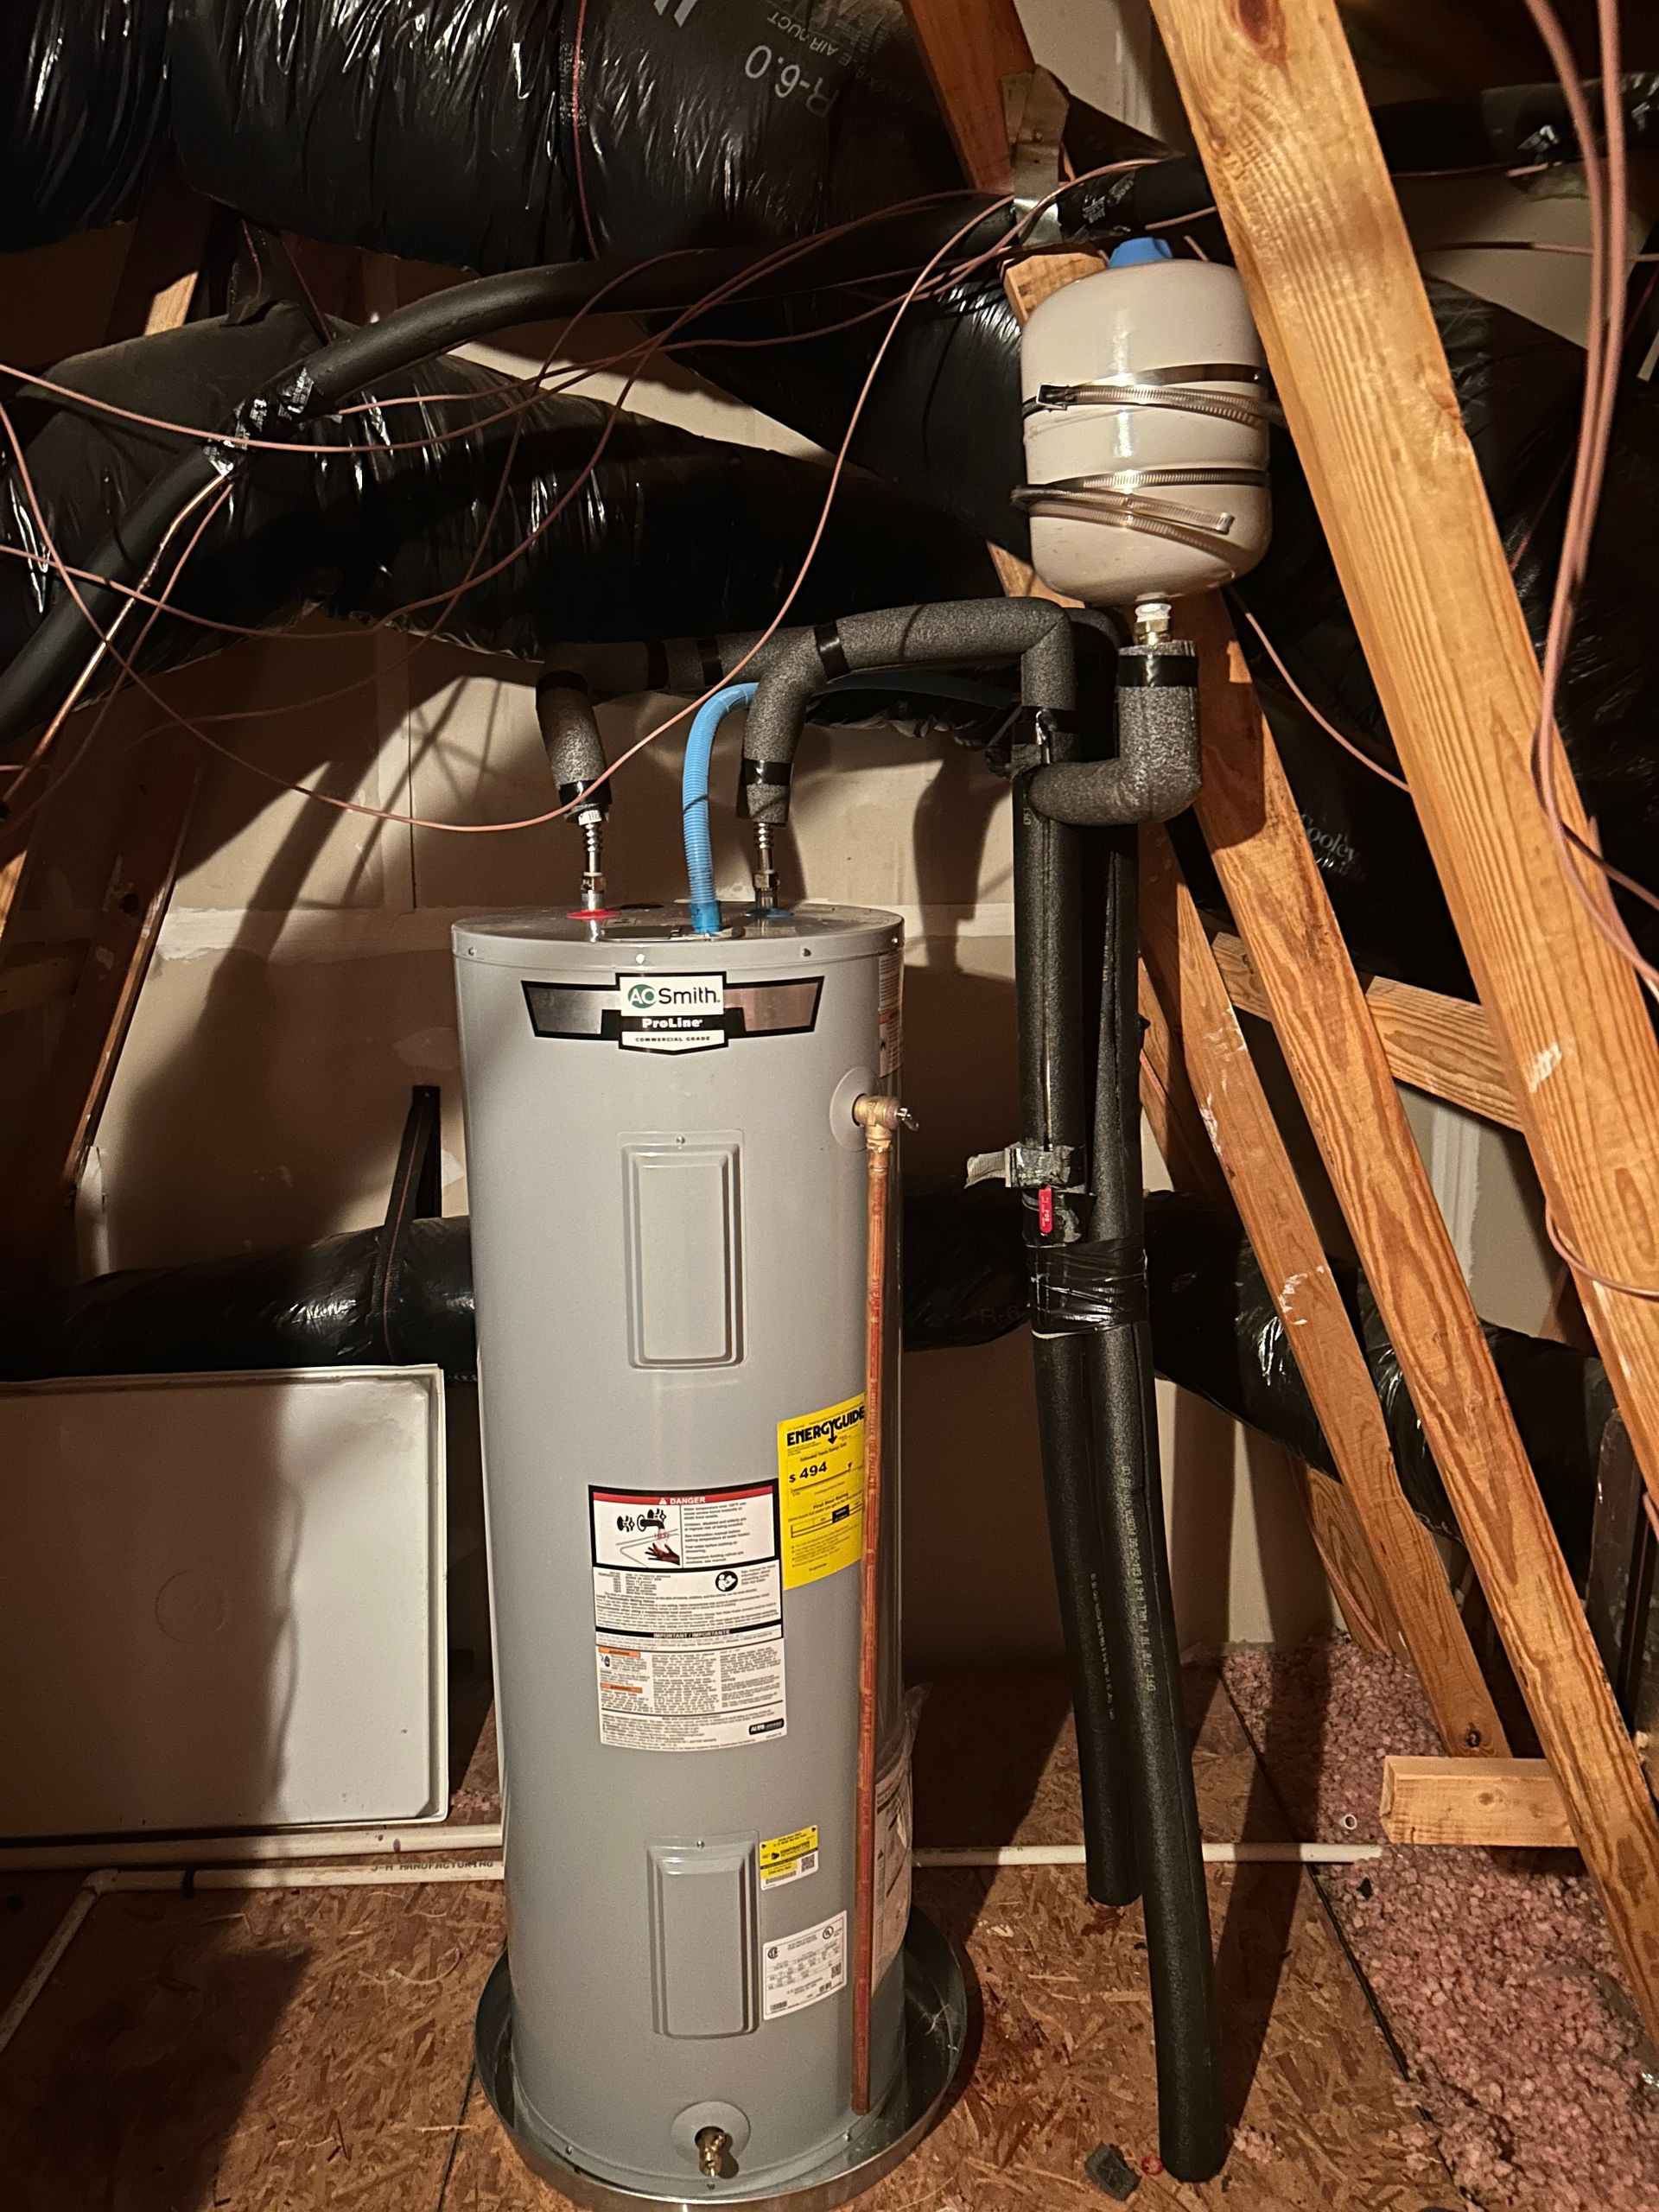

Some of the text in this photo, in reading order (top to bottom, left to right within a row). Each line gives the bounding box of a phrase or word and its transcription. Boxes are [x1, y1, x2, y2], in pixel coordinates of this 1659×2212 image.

[809, 35, 839, 57] AIR
[744, 44, 840, 118] R-6.0
[658, 986, 717, 1005] Smith
[641, 1017, 701, 1029] ProLine
[786, 1405, 865, 1446] ENERGYGUIDE
[799, 1461, 827, 1478] 494
[670, 1496, 706, 1505] DANGER
[399, 1859, 494, 1871] MANUFACTURING
